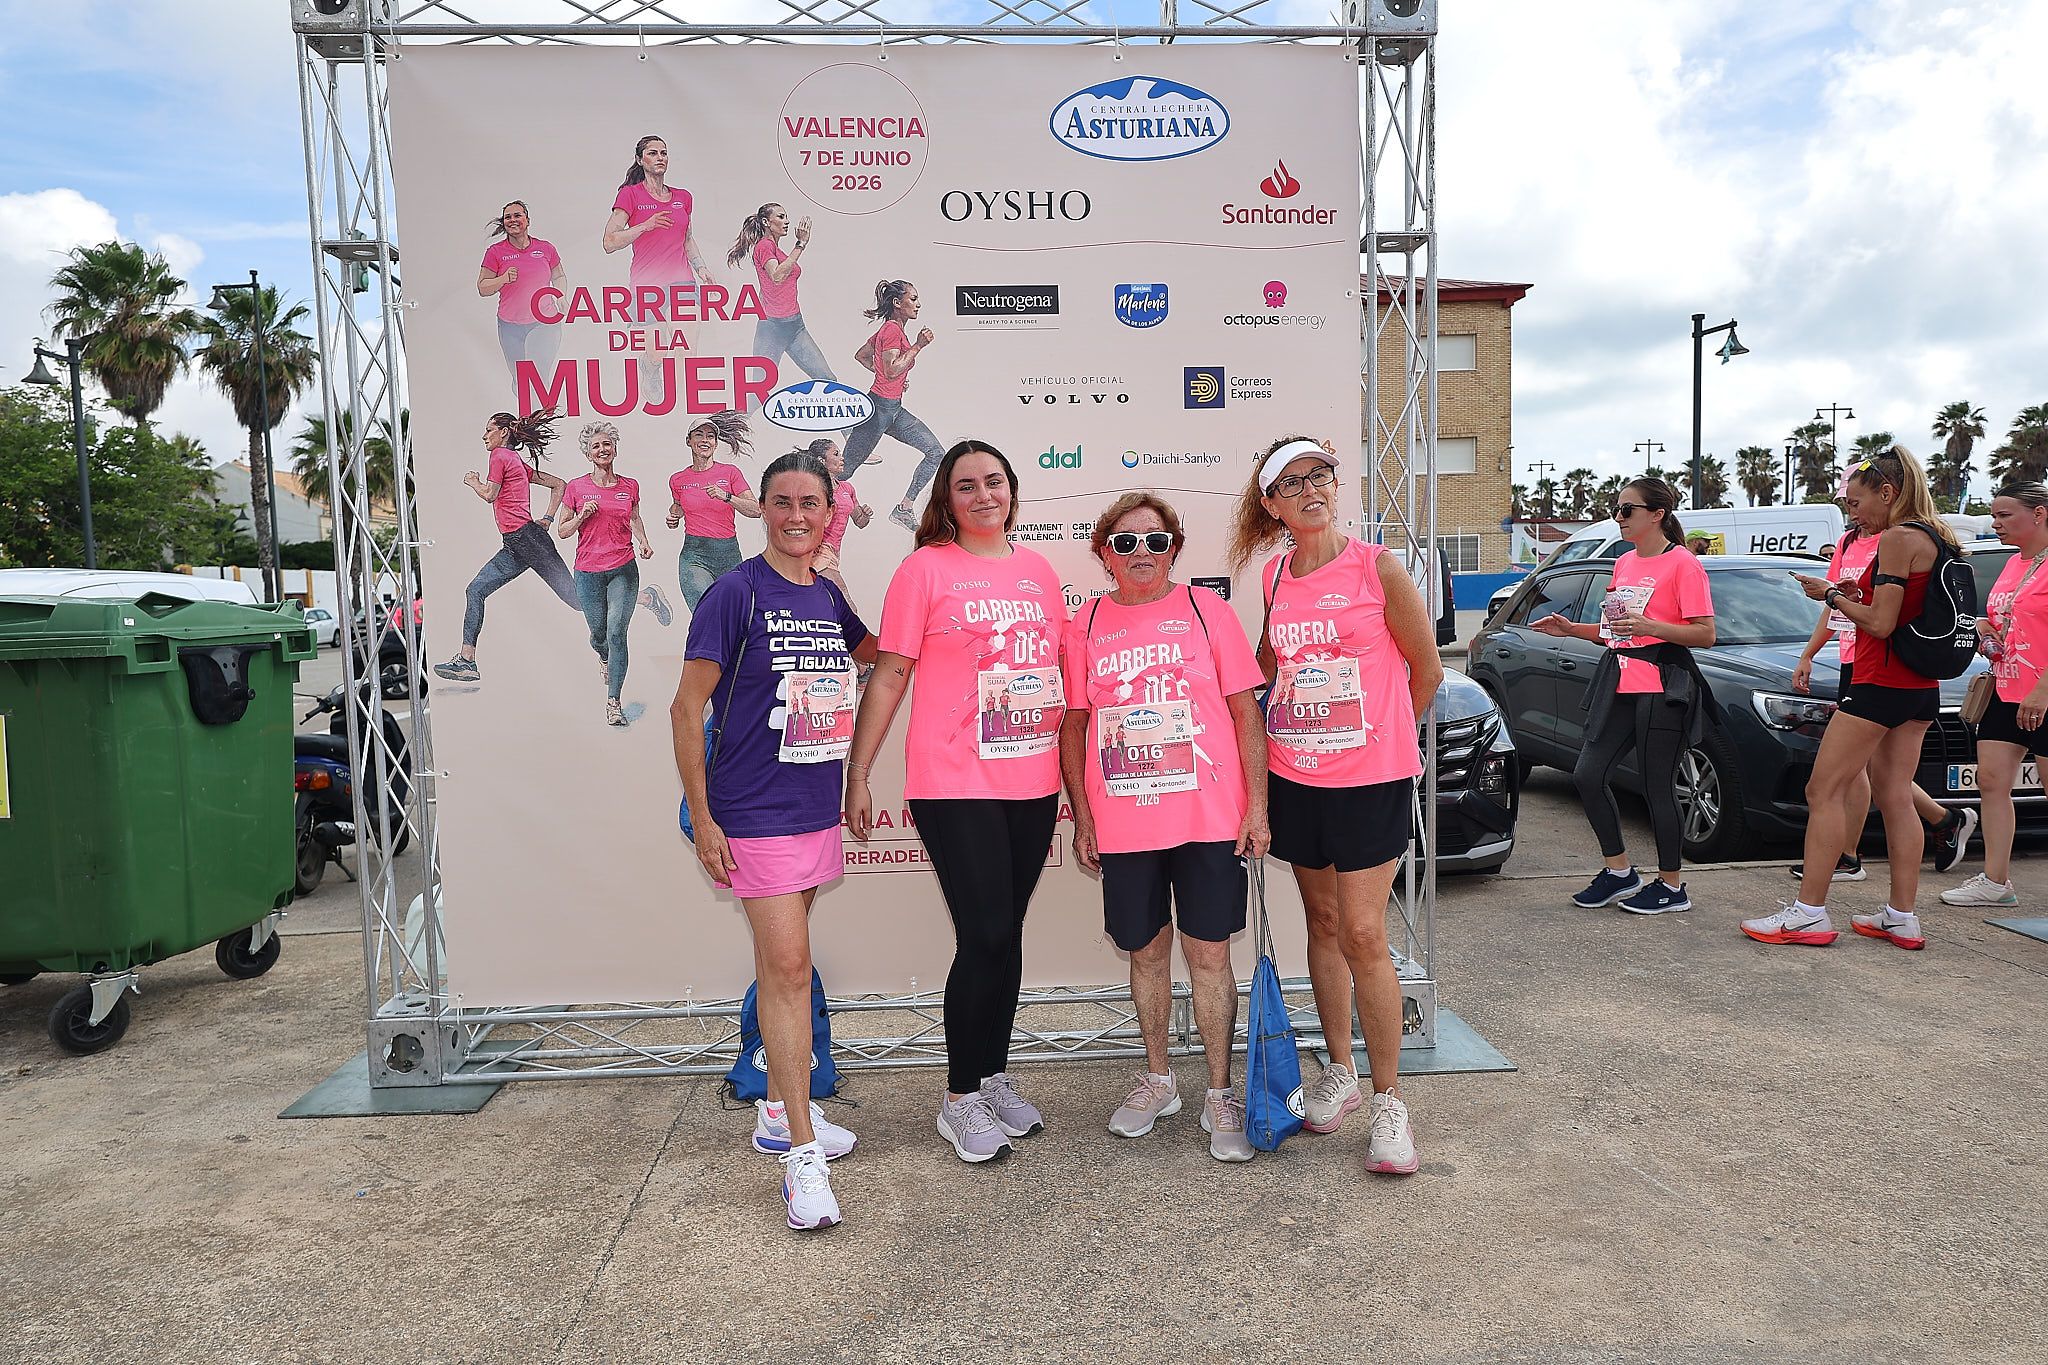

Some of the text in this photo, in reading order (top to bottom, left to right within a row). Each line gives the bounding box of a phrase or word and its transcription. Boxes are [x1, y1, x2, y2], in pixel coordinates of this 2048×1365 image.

[1090, 103, 1211, 114] CENTRAL LECHERA
[784, 117, 926, 139] VALENCIA
[1064, 106, 1218, 140] ASTURIANA
[799, 150, 912, 166] 7 DE JUNIO
[832, 174, 882, 191] 2026
[940, 189, 1092, 222] OYSHO
[1221, 203, 1338, 226] Santander
[530, 284, 767, 324] CARRERA
[962, 291, 1052, 312] Neutrogena
[1117, 293, 1166, 317] Marlene
[1223, 313, 1327, 330] octopus energy
[608, 329, 690, 352] DE LA
[516, 356, 780, 418] MUJER
[1020, 374, 1125, 386] VEHÍCULO OFICIAL
[1230, 375, 1272, 387] Correos
[1017, 393, 1130, 405] VOLVO
[1230, 388, 1272, 401] Express
[771, 399, 866, 419] ASTURIANA
[1038, 444, 1083, 469] dial
[1142, 452, 1221, 469] Daiichi-Sankyo
[1012, 523, 1063, 532] JUNTAMENT
[1072, 520, 1096, 532] capi
[1750, 532, 1809, 553] Hertz
[953, 580, 991, 591] OYSHO
[780, 610, 792, 618] 5K
[1095, 628, 1127, 648] OYSHO
[1270, 619, 1341, 648] ARRERA
[769, 637, 848, 652] CORRE
[1011, 708, 1043, 726] 016
[1293, 702, 1331, 718] 016
[811, 712, 836, 728] 016
[1125, 717, 1161, 727] ASTURIANA
[1324, 736, 1355, 744] Santander
[791, 750, 819, 758] OYSHO
[990, 745, 1020, 754] OYSHO
[1127, 744, 1164, 762] 016
[1138, 762, 1155, 771] 1272
[1294, 754, 1318, 769] 2026
[1111, 782, 1140, 791] OYSHO
[1158, 779, 1187, 788] Santander
[1135, 793, 1160, 807] 2026
